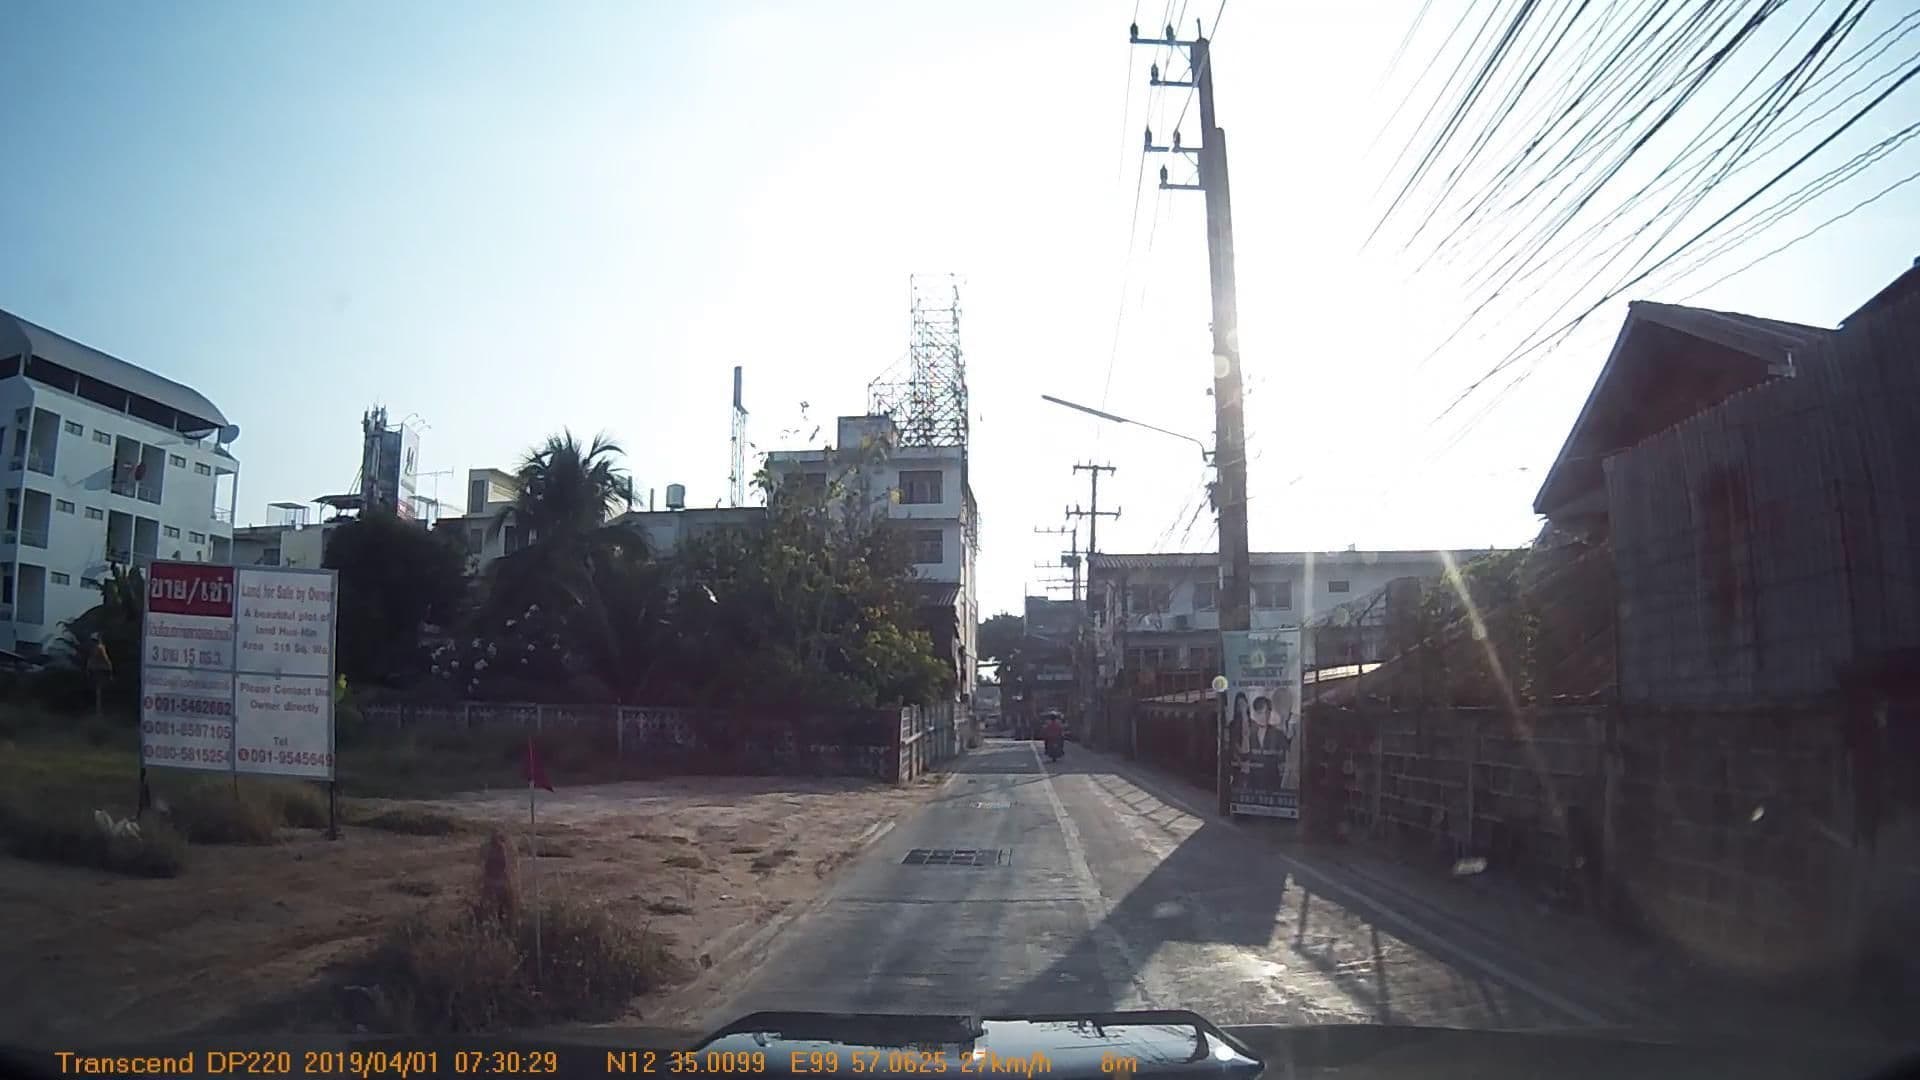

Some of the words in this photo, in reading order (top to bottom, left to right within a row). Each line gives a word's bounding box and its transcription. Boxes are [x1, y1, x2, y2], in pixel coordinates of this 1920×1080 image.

[151, 576, 232, 605] ขาย/เช่า
[151, 646, 160, 661] 3
[240, 682, 271, 695] Please
[274, 684, 312, 697] Contact
[273, 736, 288, 746] Tel
